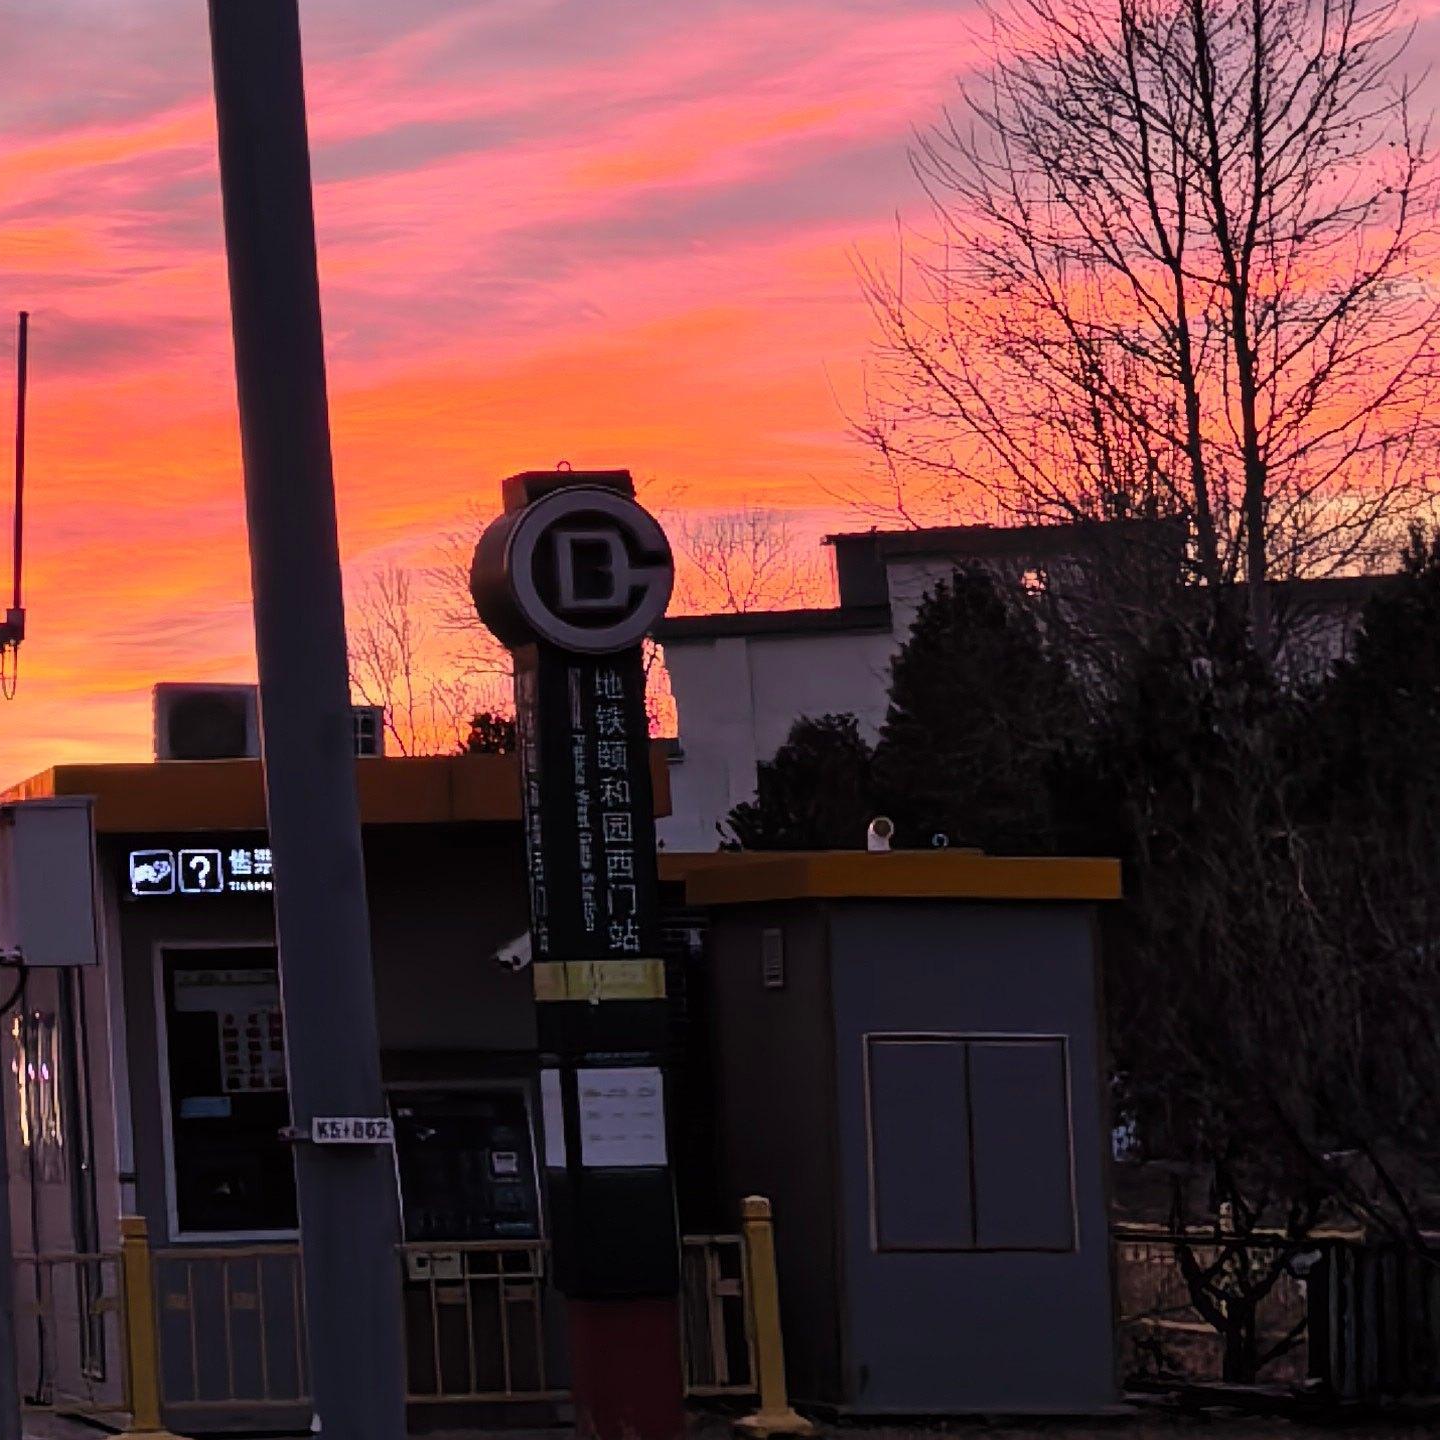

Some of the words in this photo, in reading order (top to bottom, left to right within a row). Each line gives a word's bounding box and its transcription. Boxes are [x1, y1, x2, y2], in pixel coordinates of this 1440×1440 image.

[595, 666, 640, 953] 地铁颐和园西门站
[582, 872, 597, 932] Station
